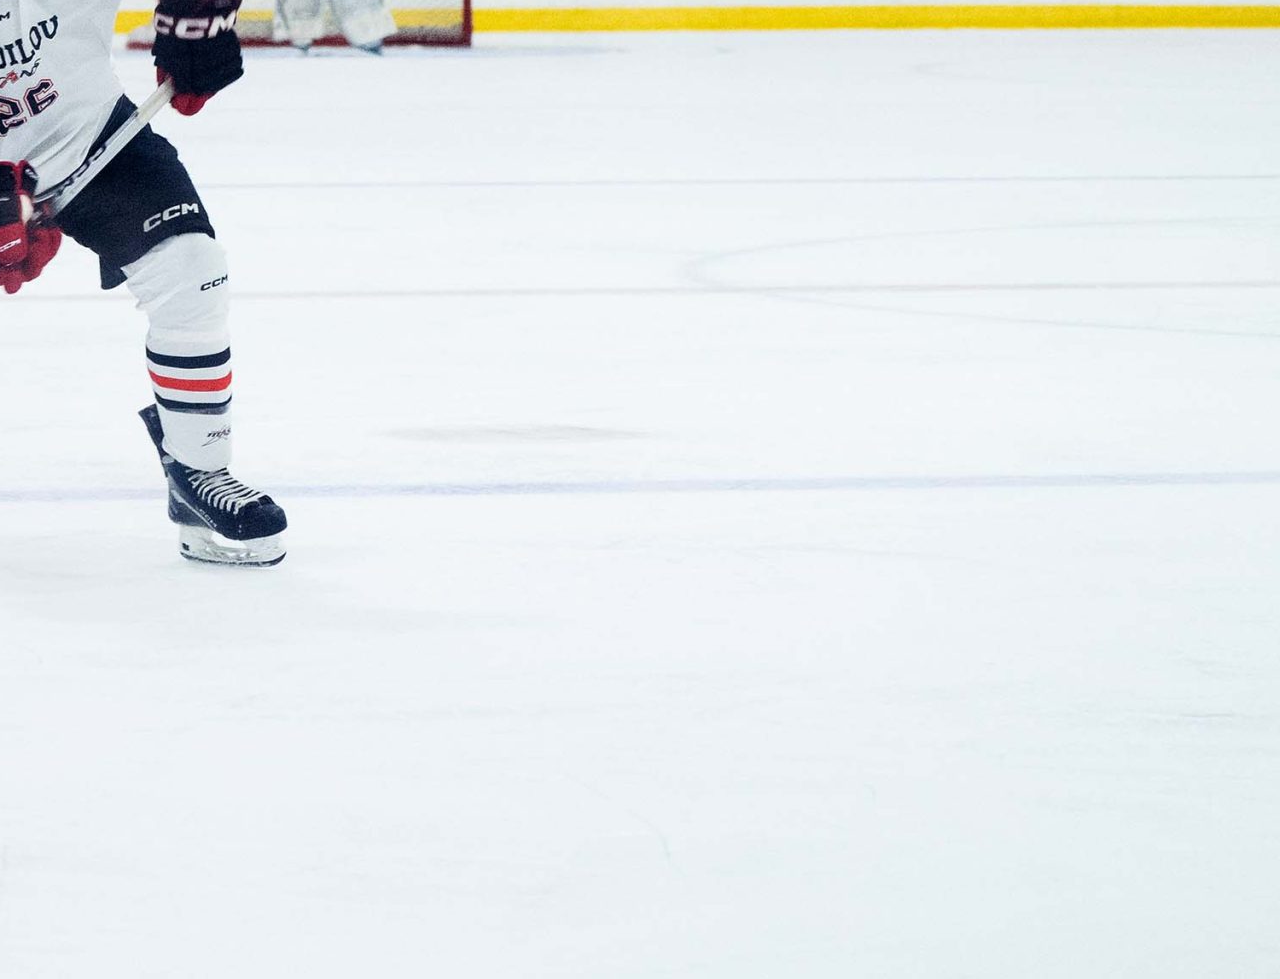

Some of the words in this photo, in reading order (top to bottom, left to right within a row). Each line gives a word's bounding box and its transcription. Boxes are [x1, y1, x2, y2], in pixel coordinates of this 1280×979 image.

[154, 9, 238, 39] CCM
[142, 201, 199, 234] CCM
[199, 273, 229, 293] CCM
